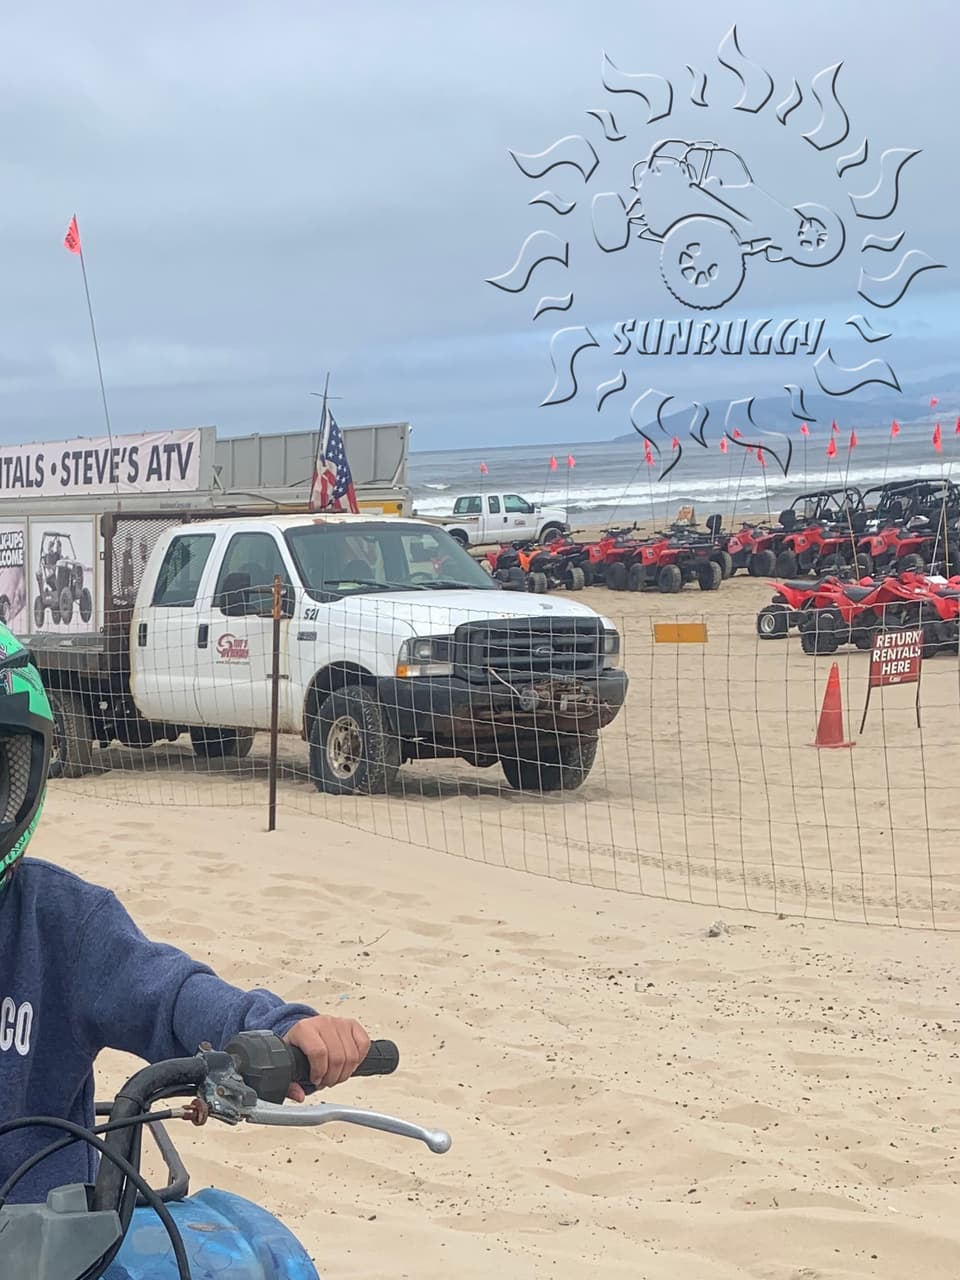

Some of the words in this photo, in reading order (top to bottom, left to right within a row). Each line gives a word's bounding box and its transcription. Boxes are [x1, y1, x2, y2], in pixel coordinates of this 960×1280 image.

[60, 446, 140, 487] STEVE'S
[145, 441, 195, 482] ATV
[876, 630, 923, 648] RETURN
[872, 645, 921, 662] RENTALS
[882, 660, 911, 675] HERE
